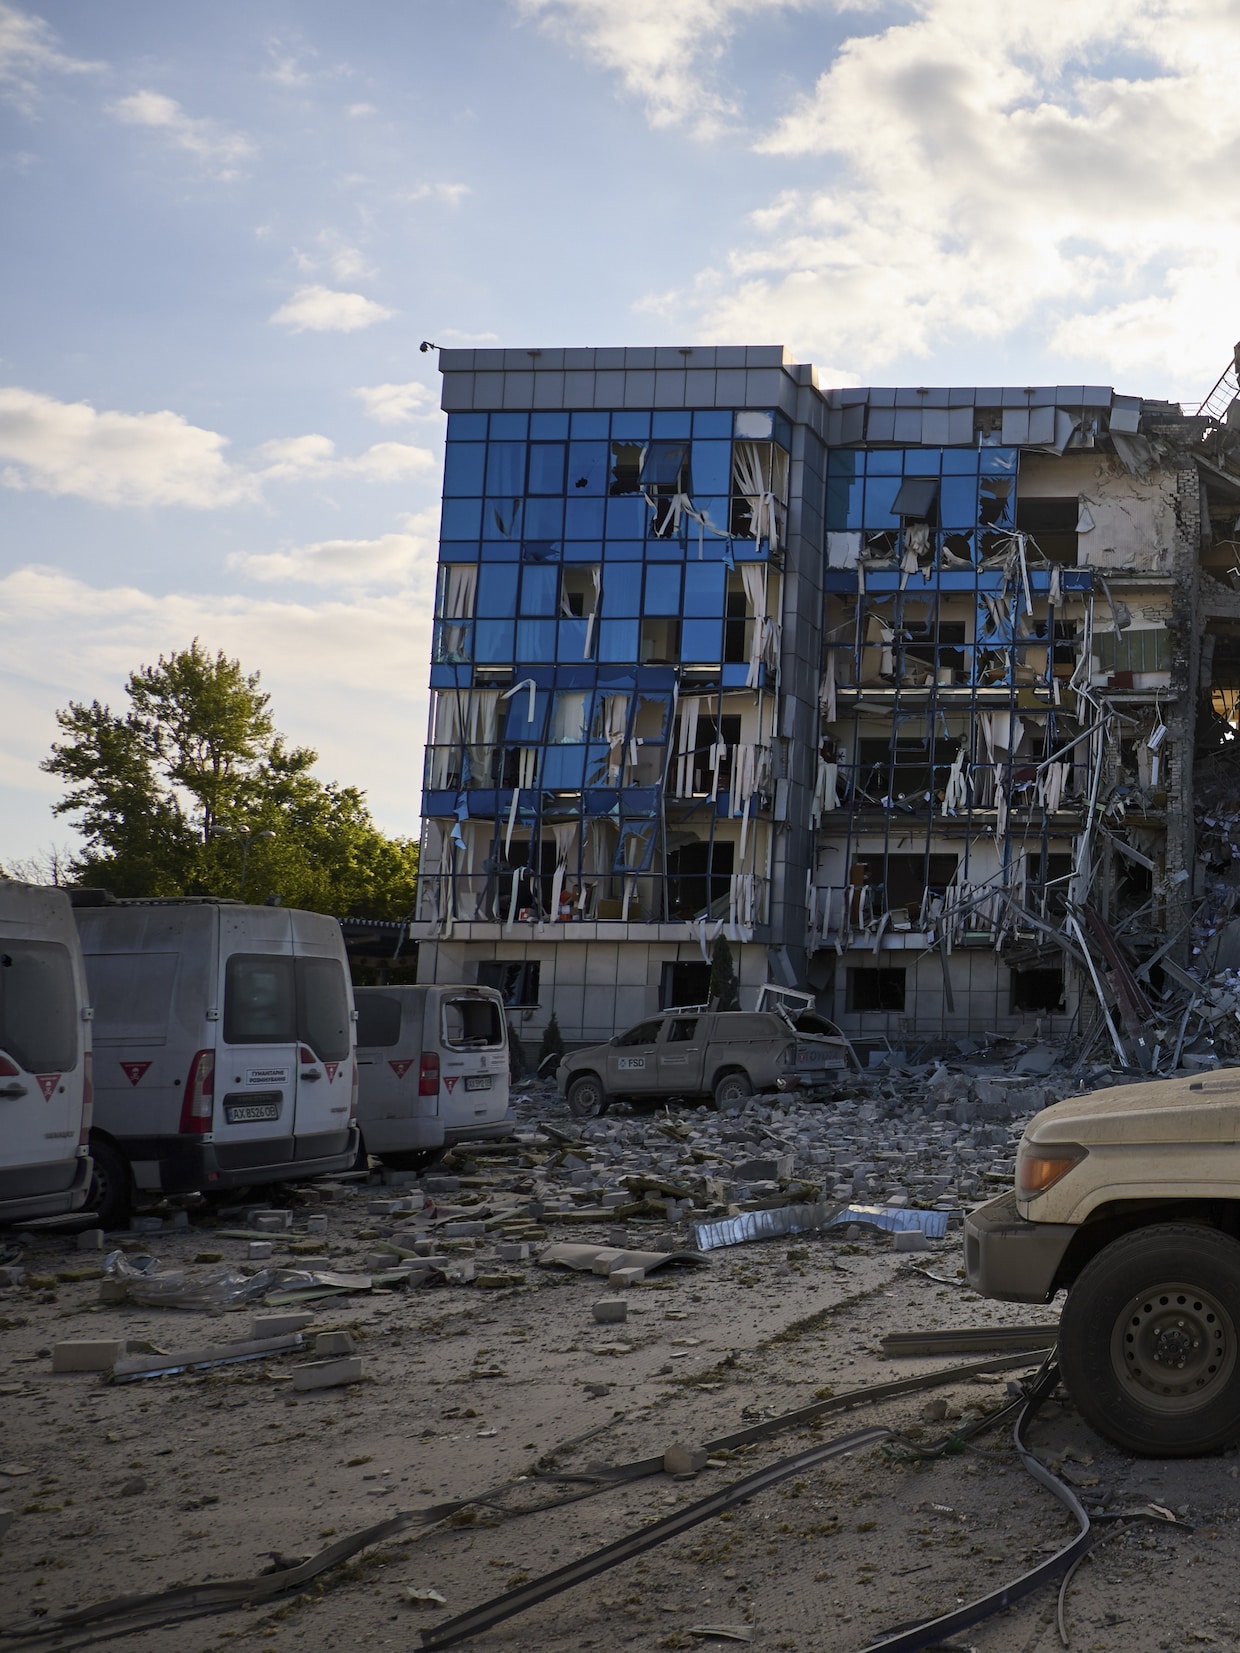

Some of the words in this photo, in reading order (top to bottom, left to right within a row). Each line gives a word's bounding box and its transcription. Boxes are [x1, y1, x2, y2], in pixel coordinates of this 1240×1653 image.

[628, 1058, 645, 1067] FSD
[233, 1108, 246, 1119] AX
[246, 1107, 264, 1118] 8526
